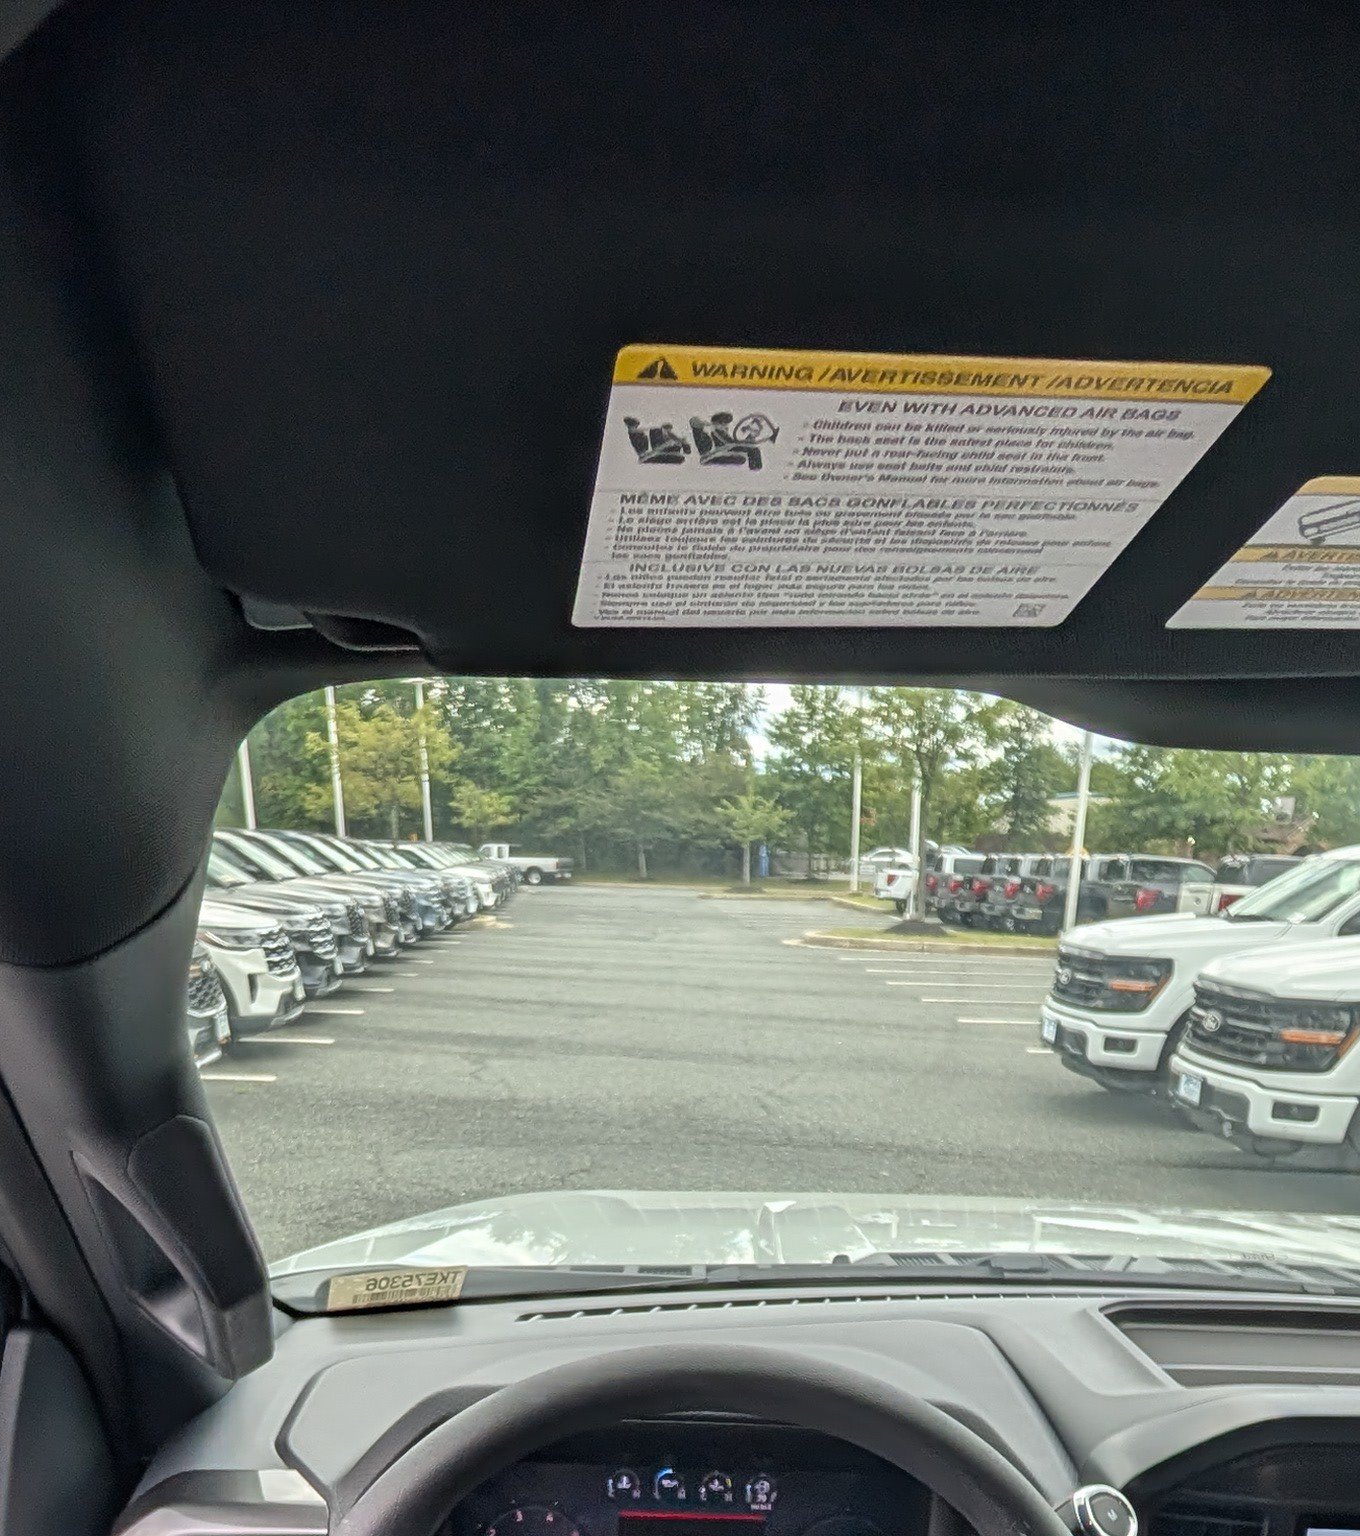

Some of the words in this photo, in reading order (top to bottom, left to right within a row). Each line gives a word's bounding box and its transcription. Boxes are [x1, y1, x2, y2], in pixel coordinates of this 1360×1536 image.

[692, 360, 814, 382] WARNING
[837, 400, 898, 414] EVEN
[903, 402, 958, 416] WITH
[960, 403, 1079, 420] ADVANCED
[1080, 406, 1119, 420] AIR
[1119, 408, 1182, 422] BAGS
[1100, 428, 1120, 440] by
